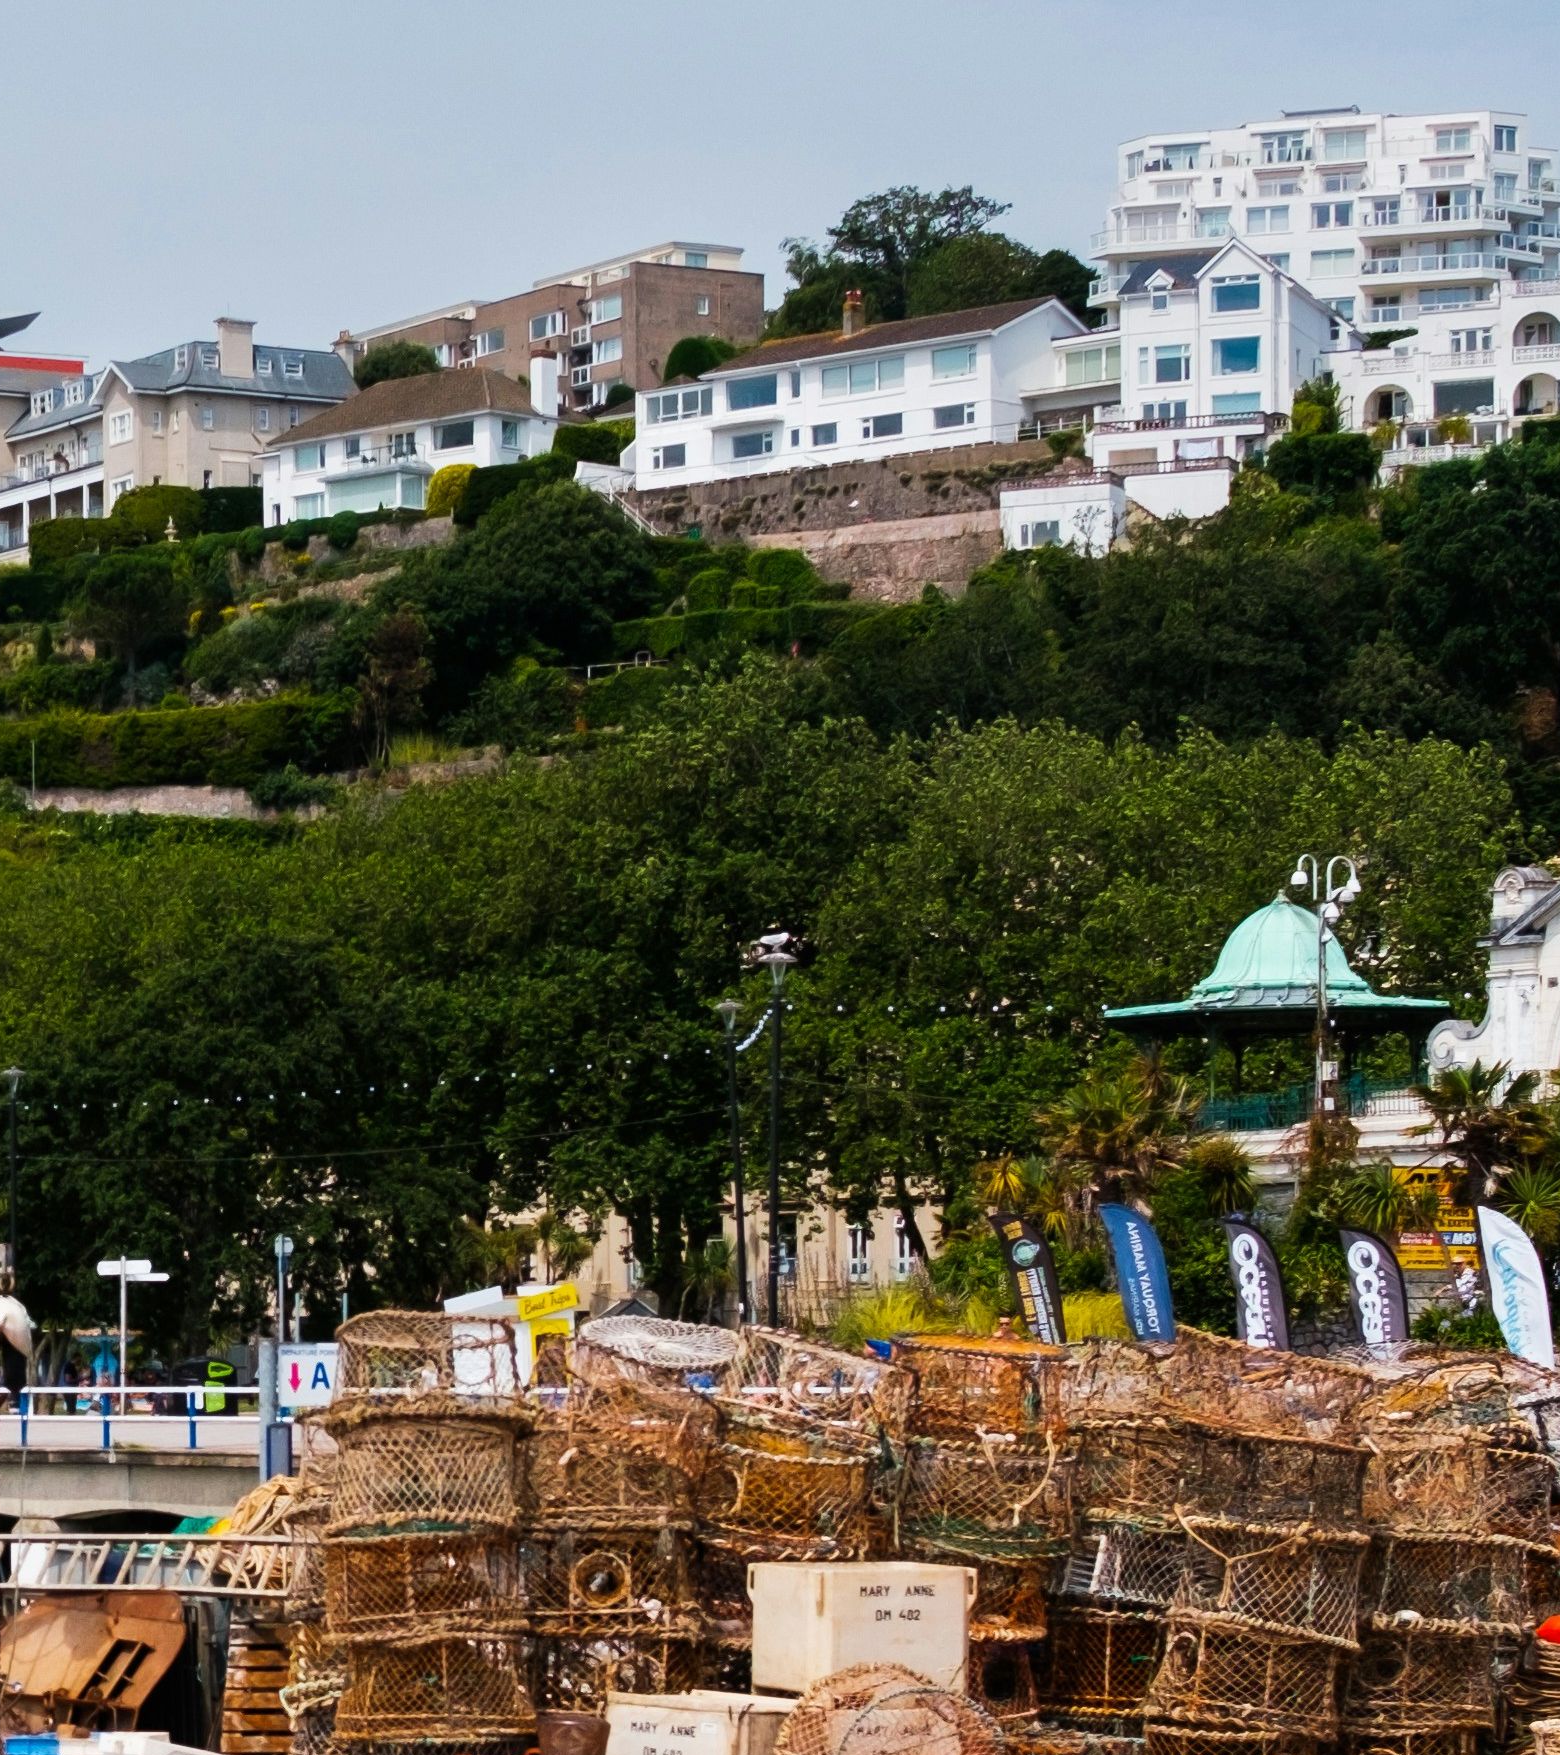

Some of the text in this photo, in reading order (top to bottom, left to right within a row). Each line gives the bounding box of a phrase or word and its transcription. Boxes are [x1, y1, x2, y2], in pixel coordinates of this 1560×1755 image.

[525, 1296, 545, 1315] Boat
[311, 1362, 331, 1389] A
[859, 1584, 936, 1598] MARY ANNE
[630, 1721, 697, 1738] MARY ANNE
